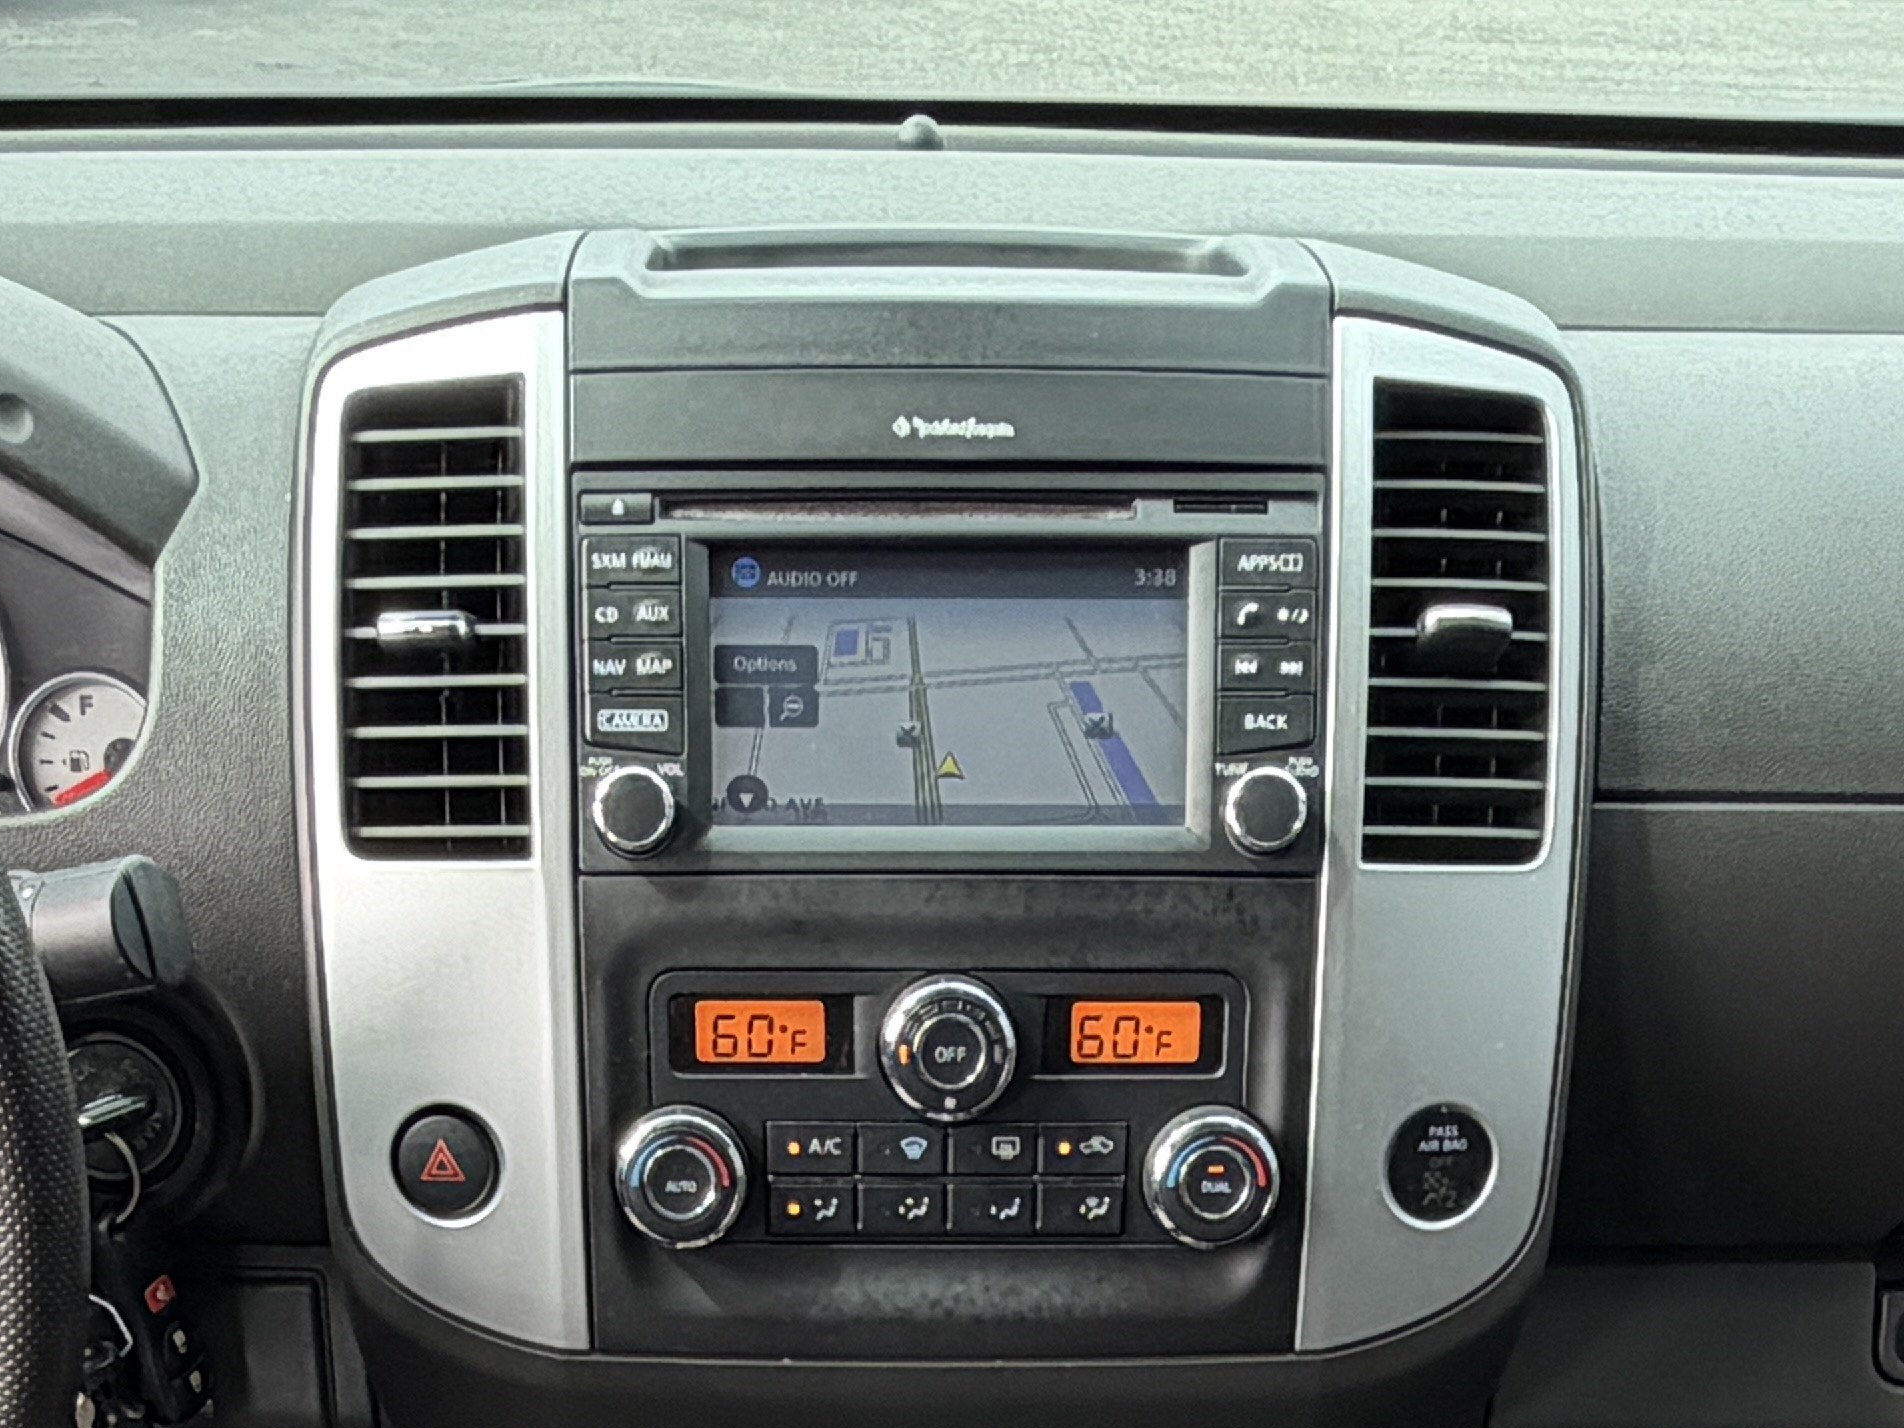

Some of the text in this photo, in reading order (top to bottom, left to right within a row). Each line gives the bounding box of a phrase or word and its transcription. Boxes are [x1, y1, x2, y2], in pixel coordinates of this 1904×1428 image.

[591, 552, 626, 569] SXM
[767, 571, 858, 587] AUDIO OFF
[594, 604, 670, 624] CD AUX
[592, 658, 673, 676] NAV MAP
[732, 655, 797, 674] Options
[79, 695, 94, 716] F
[1245, 713, 1288, 730] BACK
[934, 1046, 966, 1063] OFF
[808, 1137, 842, 1156] A/C
[664, 1180, 698, 1194] AUTO
[1200, 1181, 1232, 1194] DUAL
